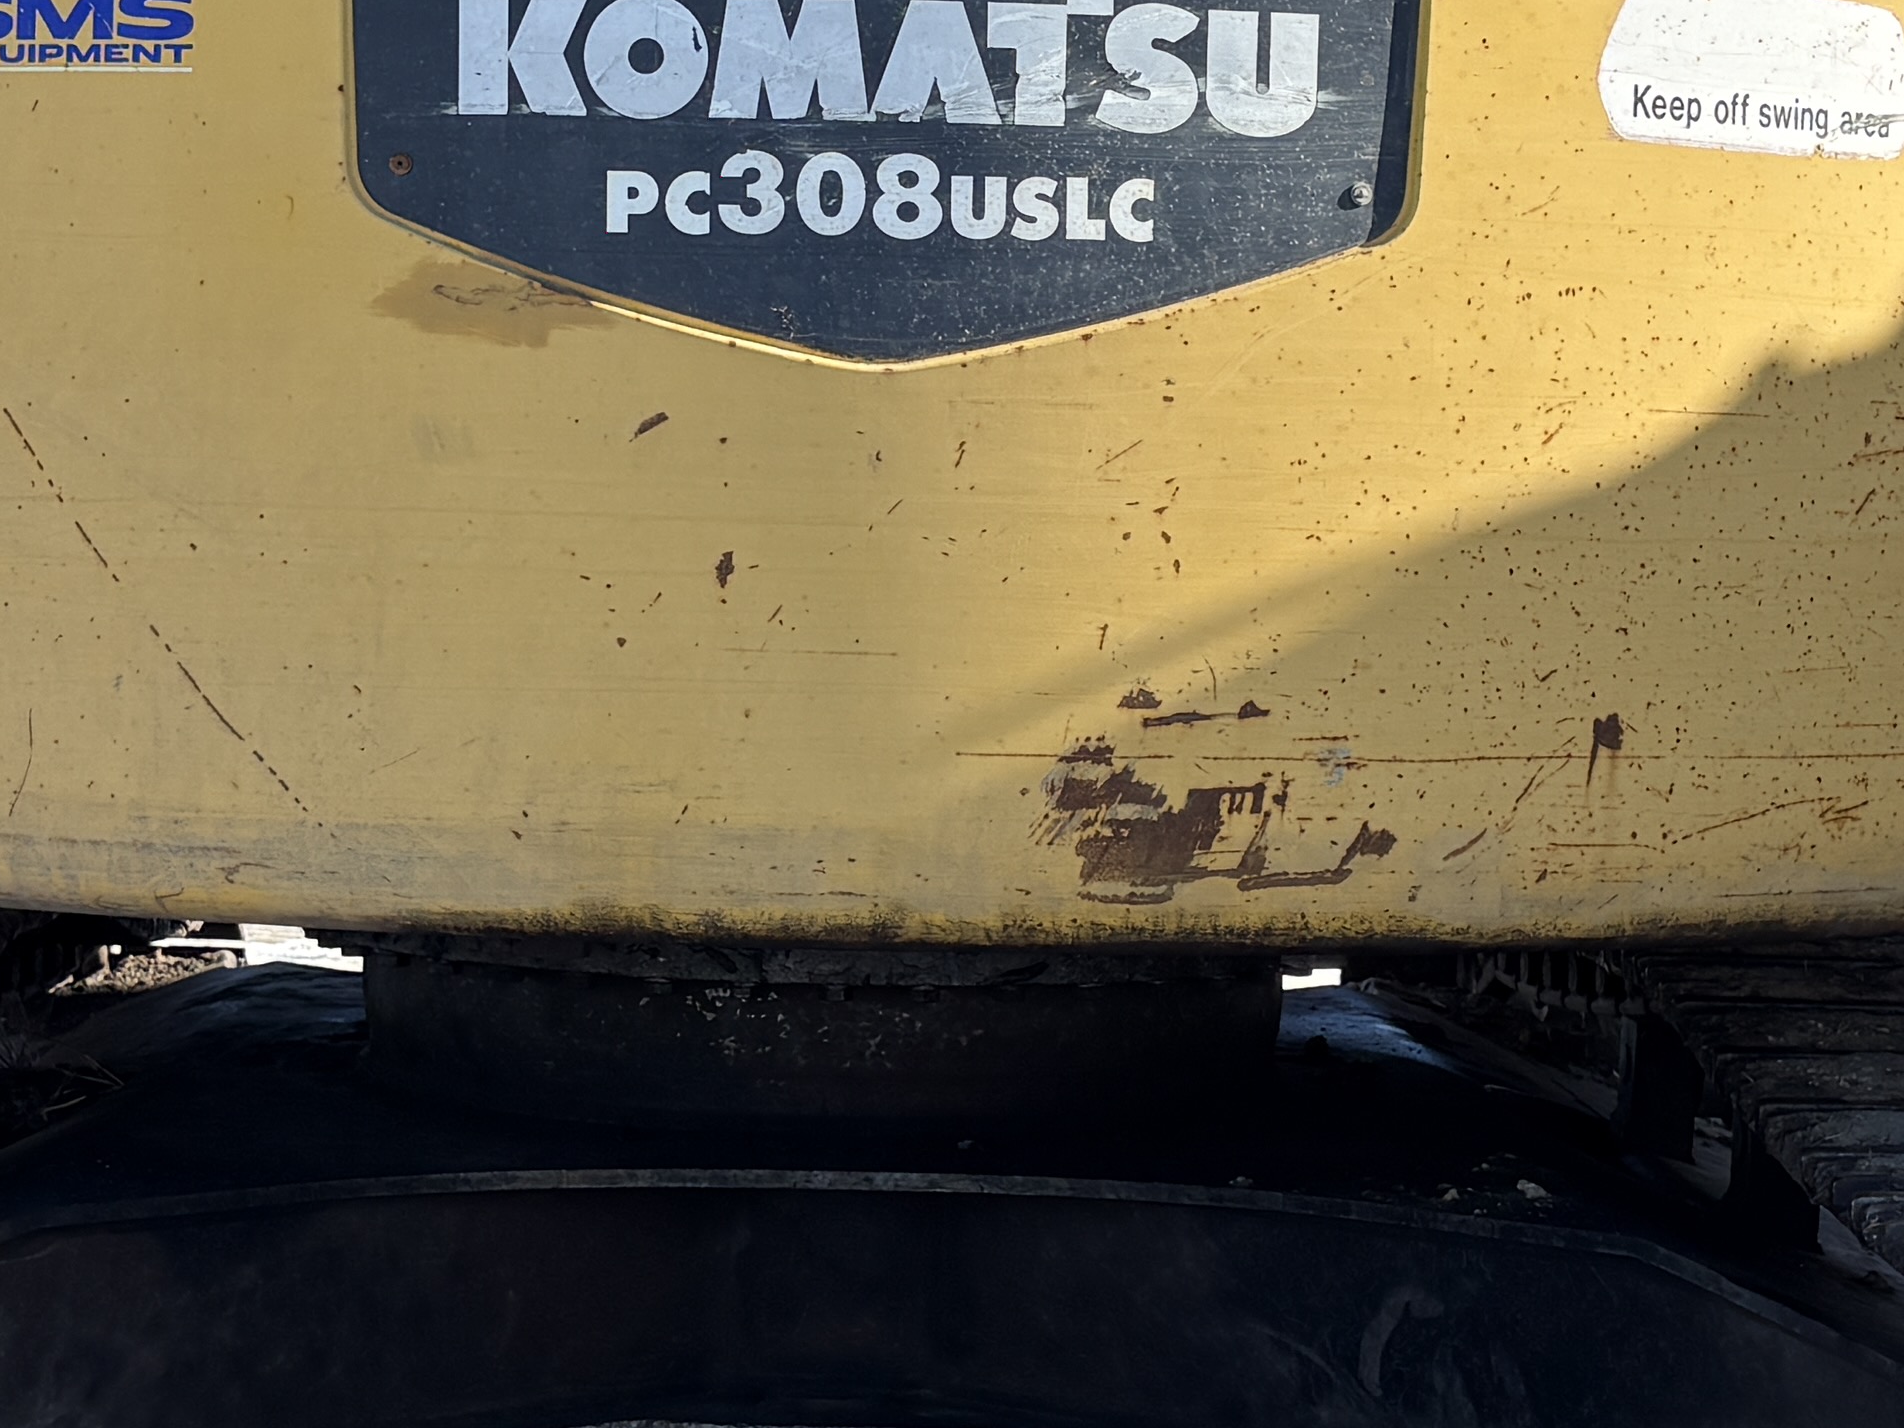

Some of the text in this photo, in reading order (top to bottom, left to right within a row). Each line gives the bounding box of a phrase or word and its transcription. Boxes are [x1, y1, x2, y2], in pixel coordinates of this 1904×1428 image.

[1632, 83, 1891, 139] Keep off swing area
[606, 148, 1156, 244] PC308USLC
